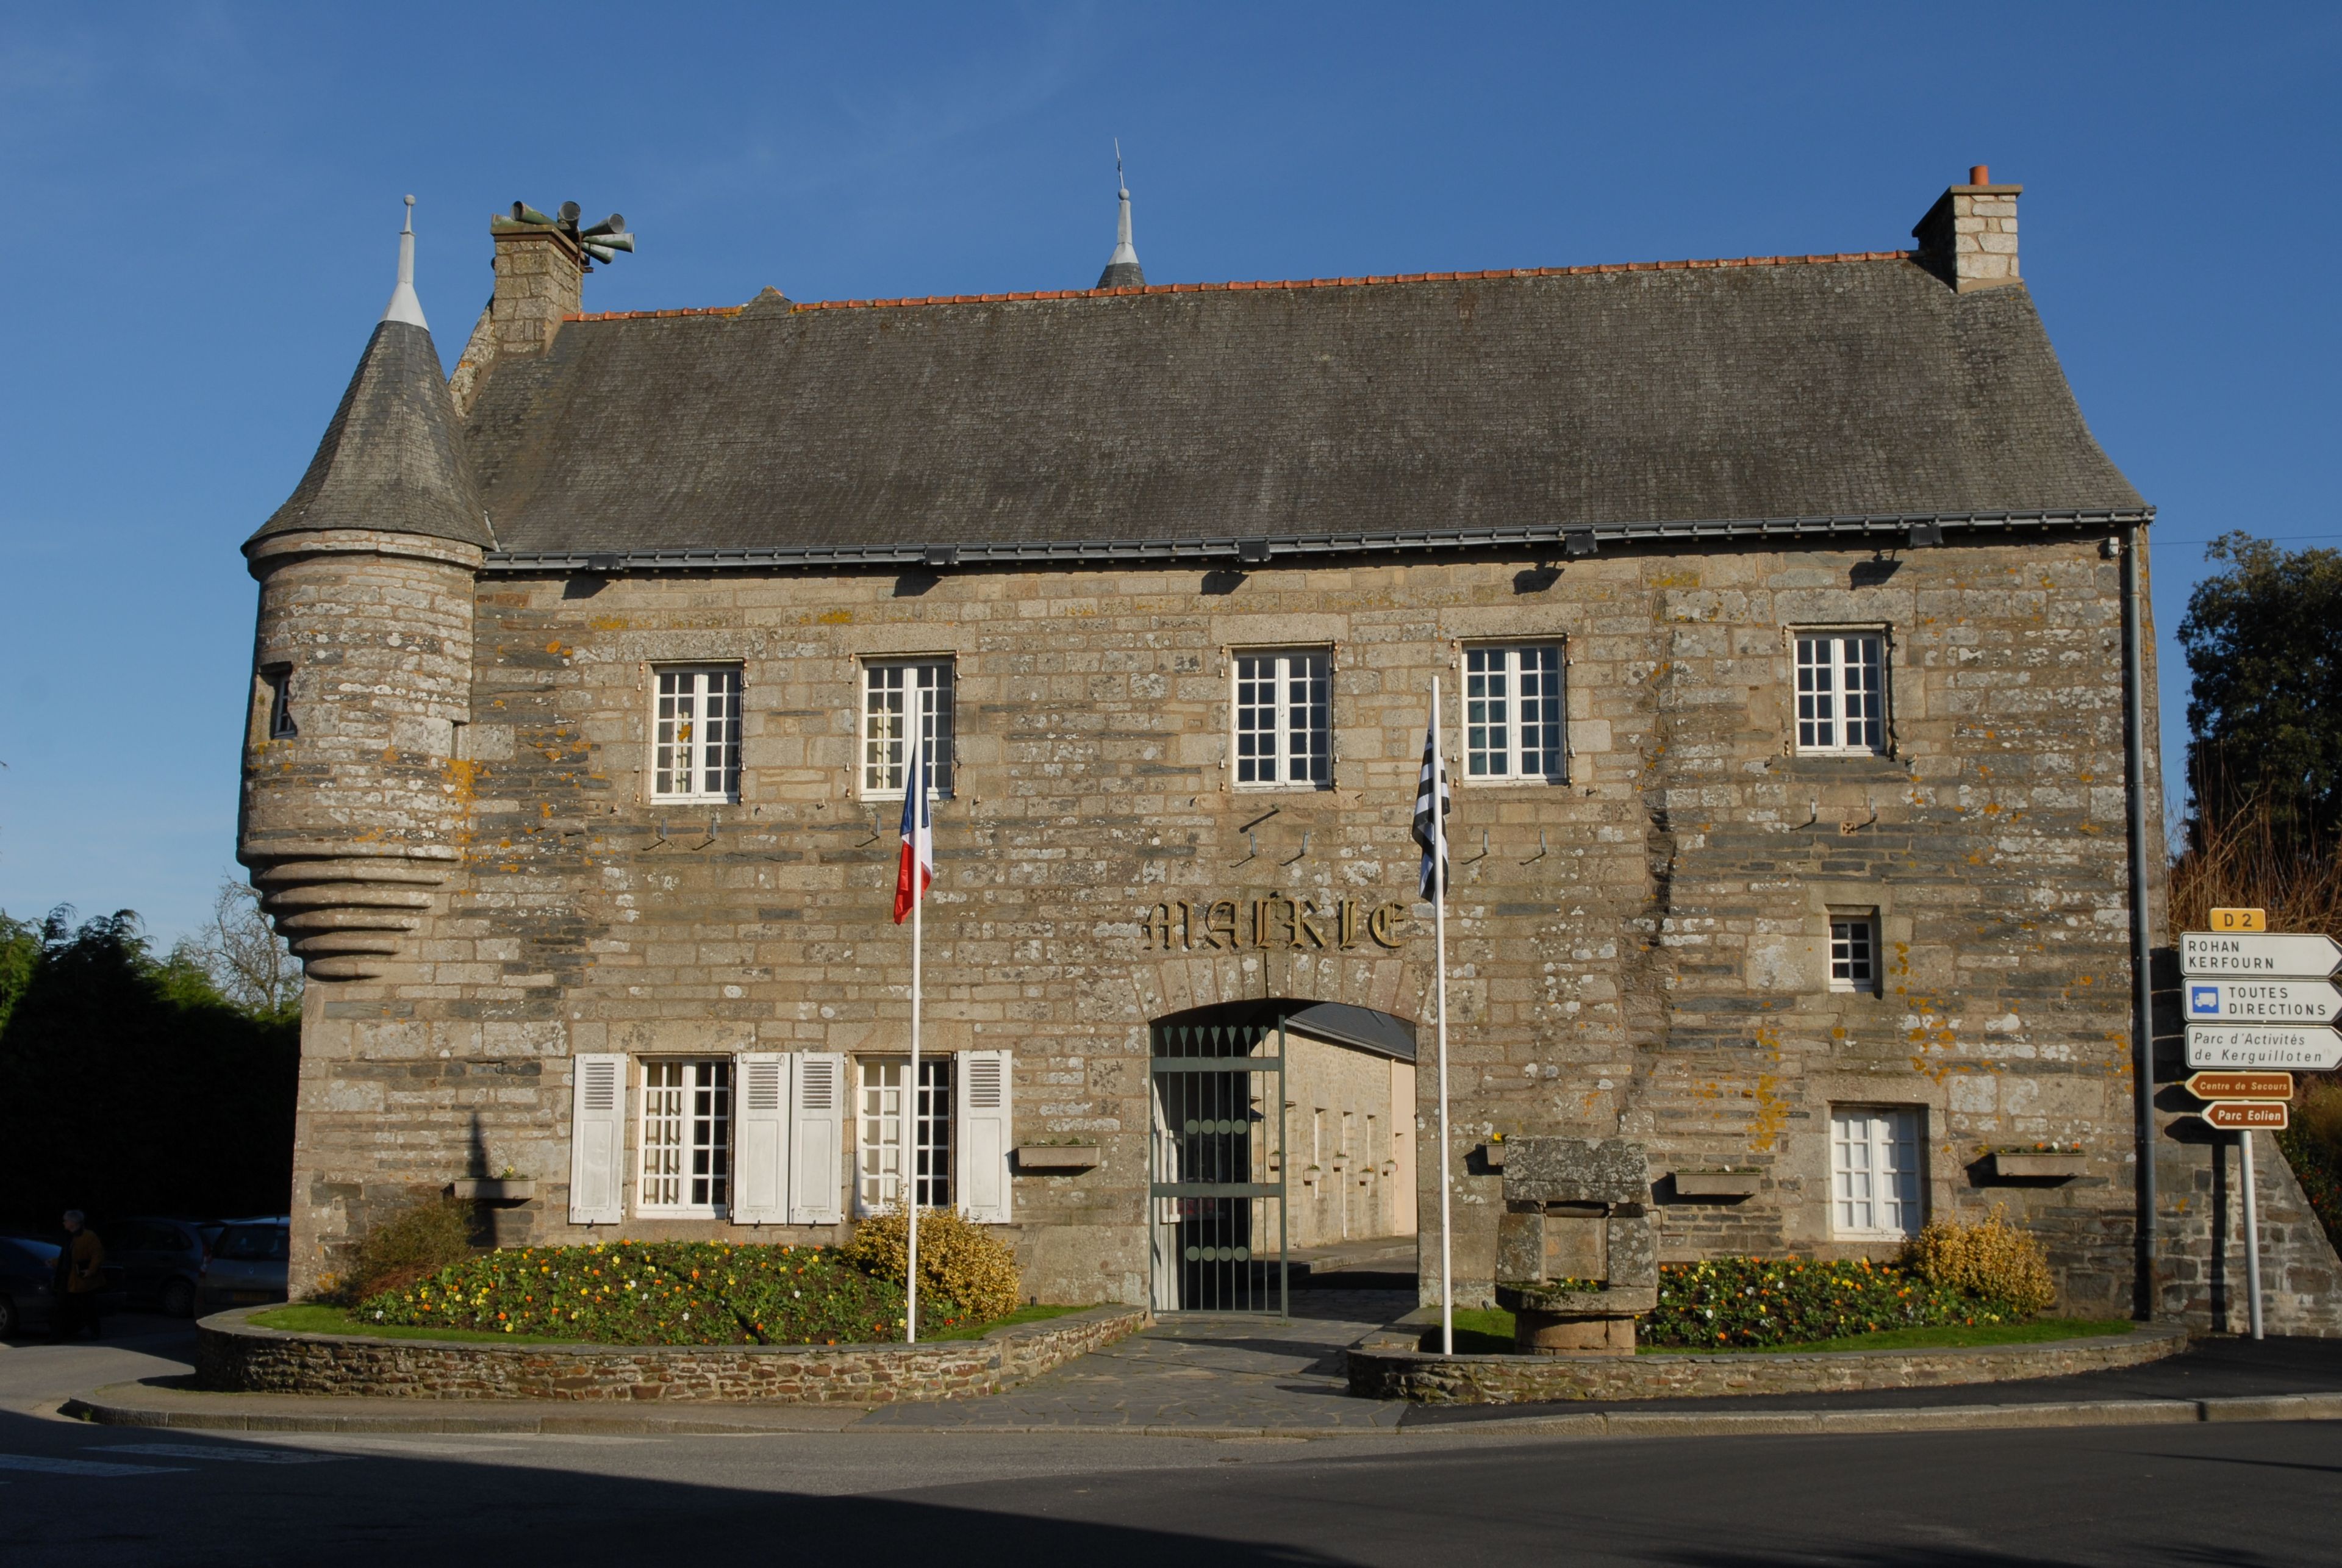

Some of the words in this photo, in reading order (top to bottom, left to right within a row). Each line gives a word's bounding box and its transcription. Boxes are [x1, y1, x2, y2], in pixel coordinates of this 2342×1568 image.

[1143, 897, 1411, 950] MAIRIE
[2224, 914, 2233, 927] D
[2243, 914, 2252, 927] 2
[2189, 941, 2239, 952] ROHAN
[2189, 957, 2273, 968] KERFOURN
[2229, 987, 2288, 998] TOUTES
[2230, 1003, 2326, 1015] DIRECTIONS
[2194, 1033, 2223, 1044] Parc
[2231, 1033, 2305, 1045] d'Activités
[2195, 1049, 2211, 1060] de
[2222, 1049, 2322, 1064] Kerguilloten
[2200, 1082, 2230, 1090] Centre
[2236, 1082, 2246, 1090] de
[2251, 1082, 2287, 1090] Secours
[2218, 1109, 2242, 1121] Parc
[2247, 1110, 2281, 1121] Eolien
